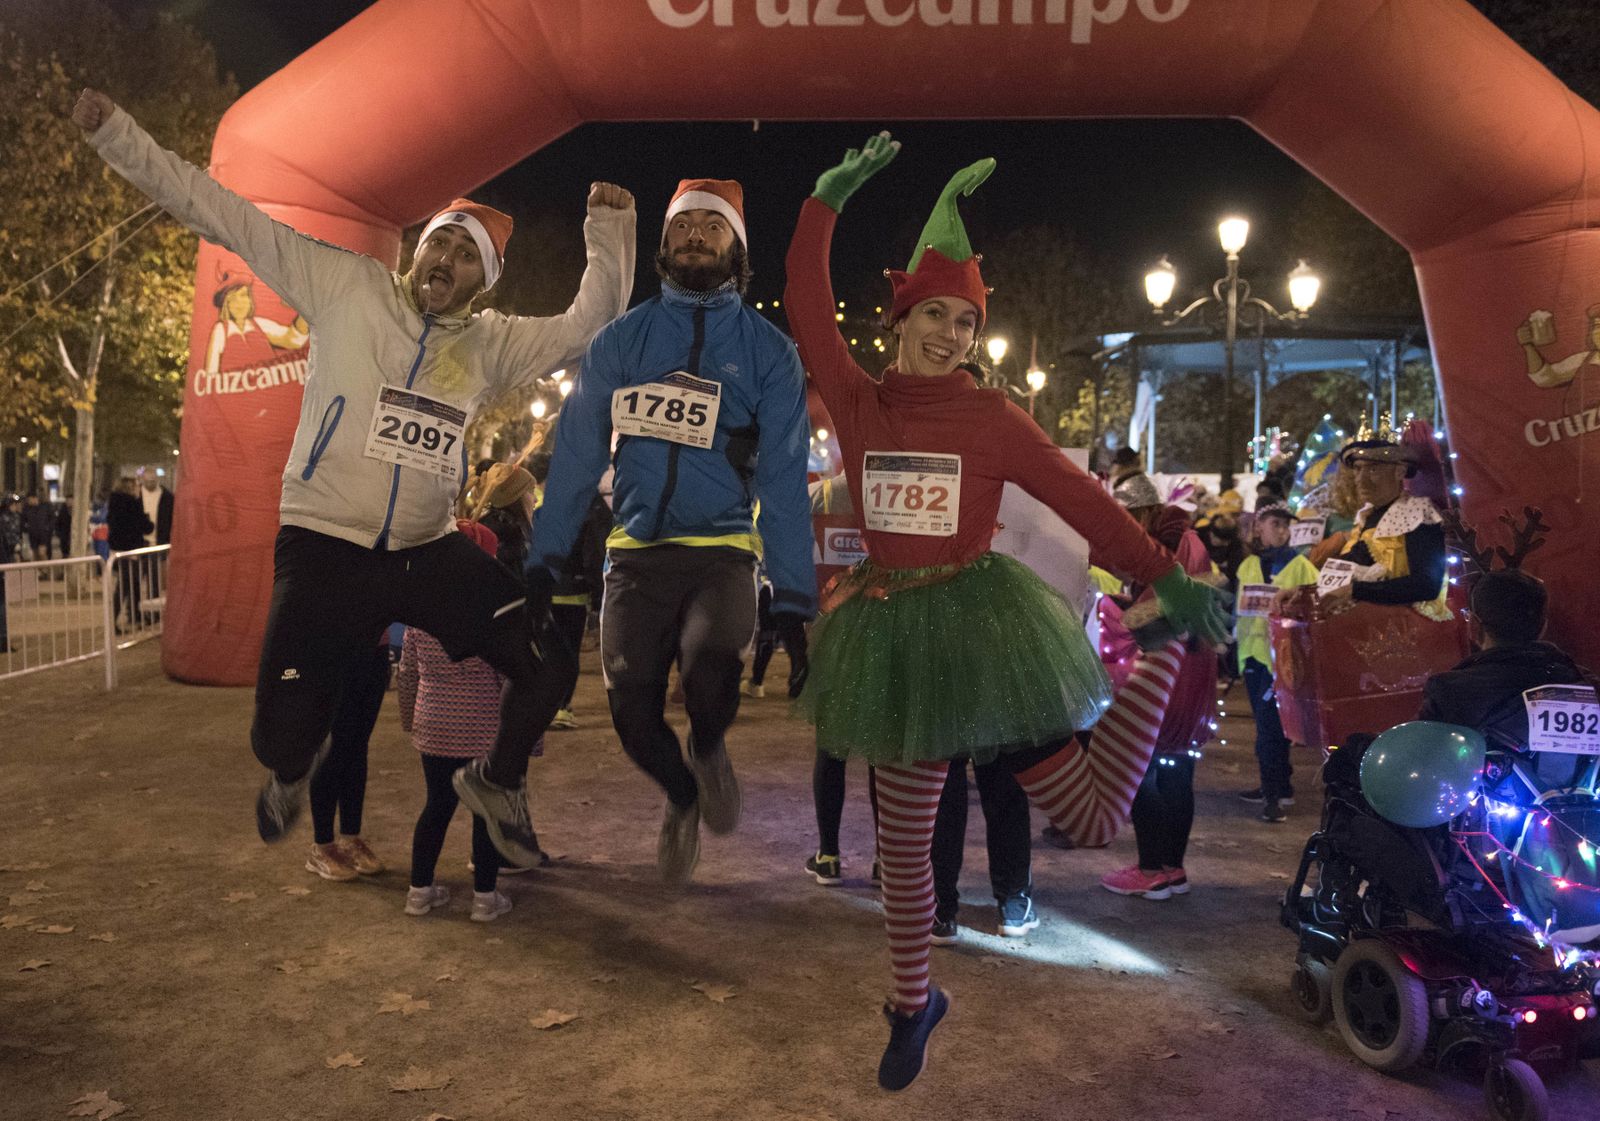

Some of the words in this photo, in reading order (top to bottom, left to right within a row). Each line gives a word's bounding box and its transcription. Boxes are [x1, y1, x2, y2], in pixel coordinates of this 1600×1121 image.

[623, 391, 708, 427] 1785
[378, 415, 457, 456] 2097
[870, 482, 949, 513] 1782
[1537, 710, 1599, 735] 1982
